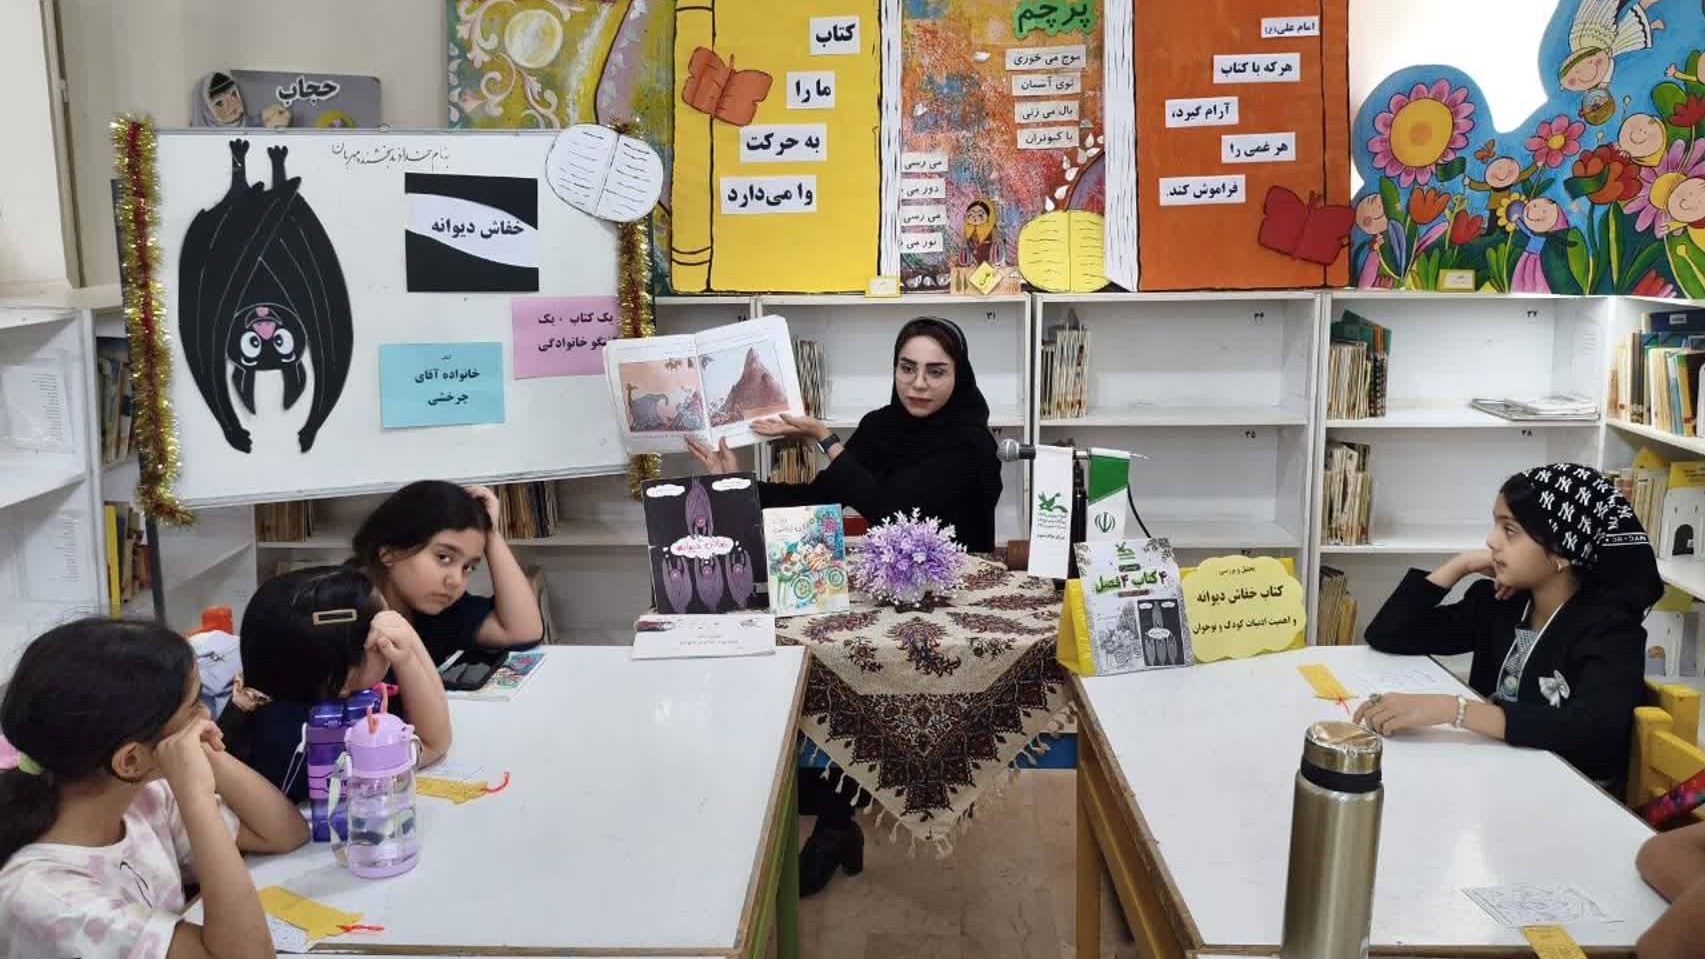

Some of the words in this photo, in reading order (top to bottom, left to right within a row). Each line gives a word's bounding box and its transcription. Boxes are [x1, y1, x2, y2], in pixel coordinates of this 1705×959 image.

[1018, 3, 1090, 33] پرچم
[1297, 21, 1315, 34] امام
[815, 23, 856, 48] کتاب
[1013, 53, 1041, 66] خوری
[1044, 55, 1058, 65] می
[1221, 61, 1249, 76] کتاب
[1251, 61, 1260, 77] با
[795, 79, 811, 103] را
[816, 78, 832, 97] ما
[1021, 76, 1052, 91] آسمان
[1055, 79, 1074, 91] توی
[276, 76, 340, 107] حجاب
[1042, 110, 1056, 119] می
[1058, 105, 1073, 117] بال
[1205, 102, 1231, 120] آرام
[746, 132, 799, 156] حرکت
[805, 135, 820, 154] به
[1025, 131, 1063, 146] کبوتران
[1065, 131, 1073, 143] با
[330, 140, 361, 172] مهربان
[1229, 142, 1241, 158] را
[1243, 142, 1271, 158] غمی
[1274, 142, 1289, 157] هر
[904, 160, 927, 171] رسی
[928, 160, 942, 170] می
[797, 182, 814, 206] وا
[906, 187, 919, 196] می
[922, 186, 940, 196] دور
[1193, 181, 1239, 199] فراموش
[903, 213, 925, 223] رسی
[927, 213, 941, 222] می
[431, 218, 476, 240] دیوانه
[480, 219, 525, 239] خفاش
[906, 240, 919, 250] می
[538, 313, 555, 326] یک
[569, 312, 594, 326] کتاب
[597, 312, 613, 326] یک
[538, 336, 588, 352] خانوادگی
[414, 367, 440, 384] آقای
[441, 367, 480, 383] خانواده
[1095, 575, 1121, 594] فصل
[1120, 573, 1129, 588] ۴
[1131, 569, 1158, 588] کتاب
[1158, 570, 1168, 585] ۴
[1196, 590, 1225, 606] دیوانه
[1228, 586, 1257, 604] خفاش
[1260, 584, 1284, 601] کتاب
[1223, 618, 1244, 631] کودک
[1245, 617, 1267, 628] ادبیات
[1268, 616, 1291, 627] اهمیت
